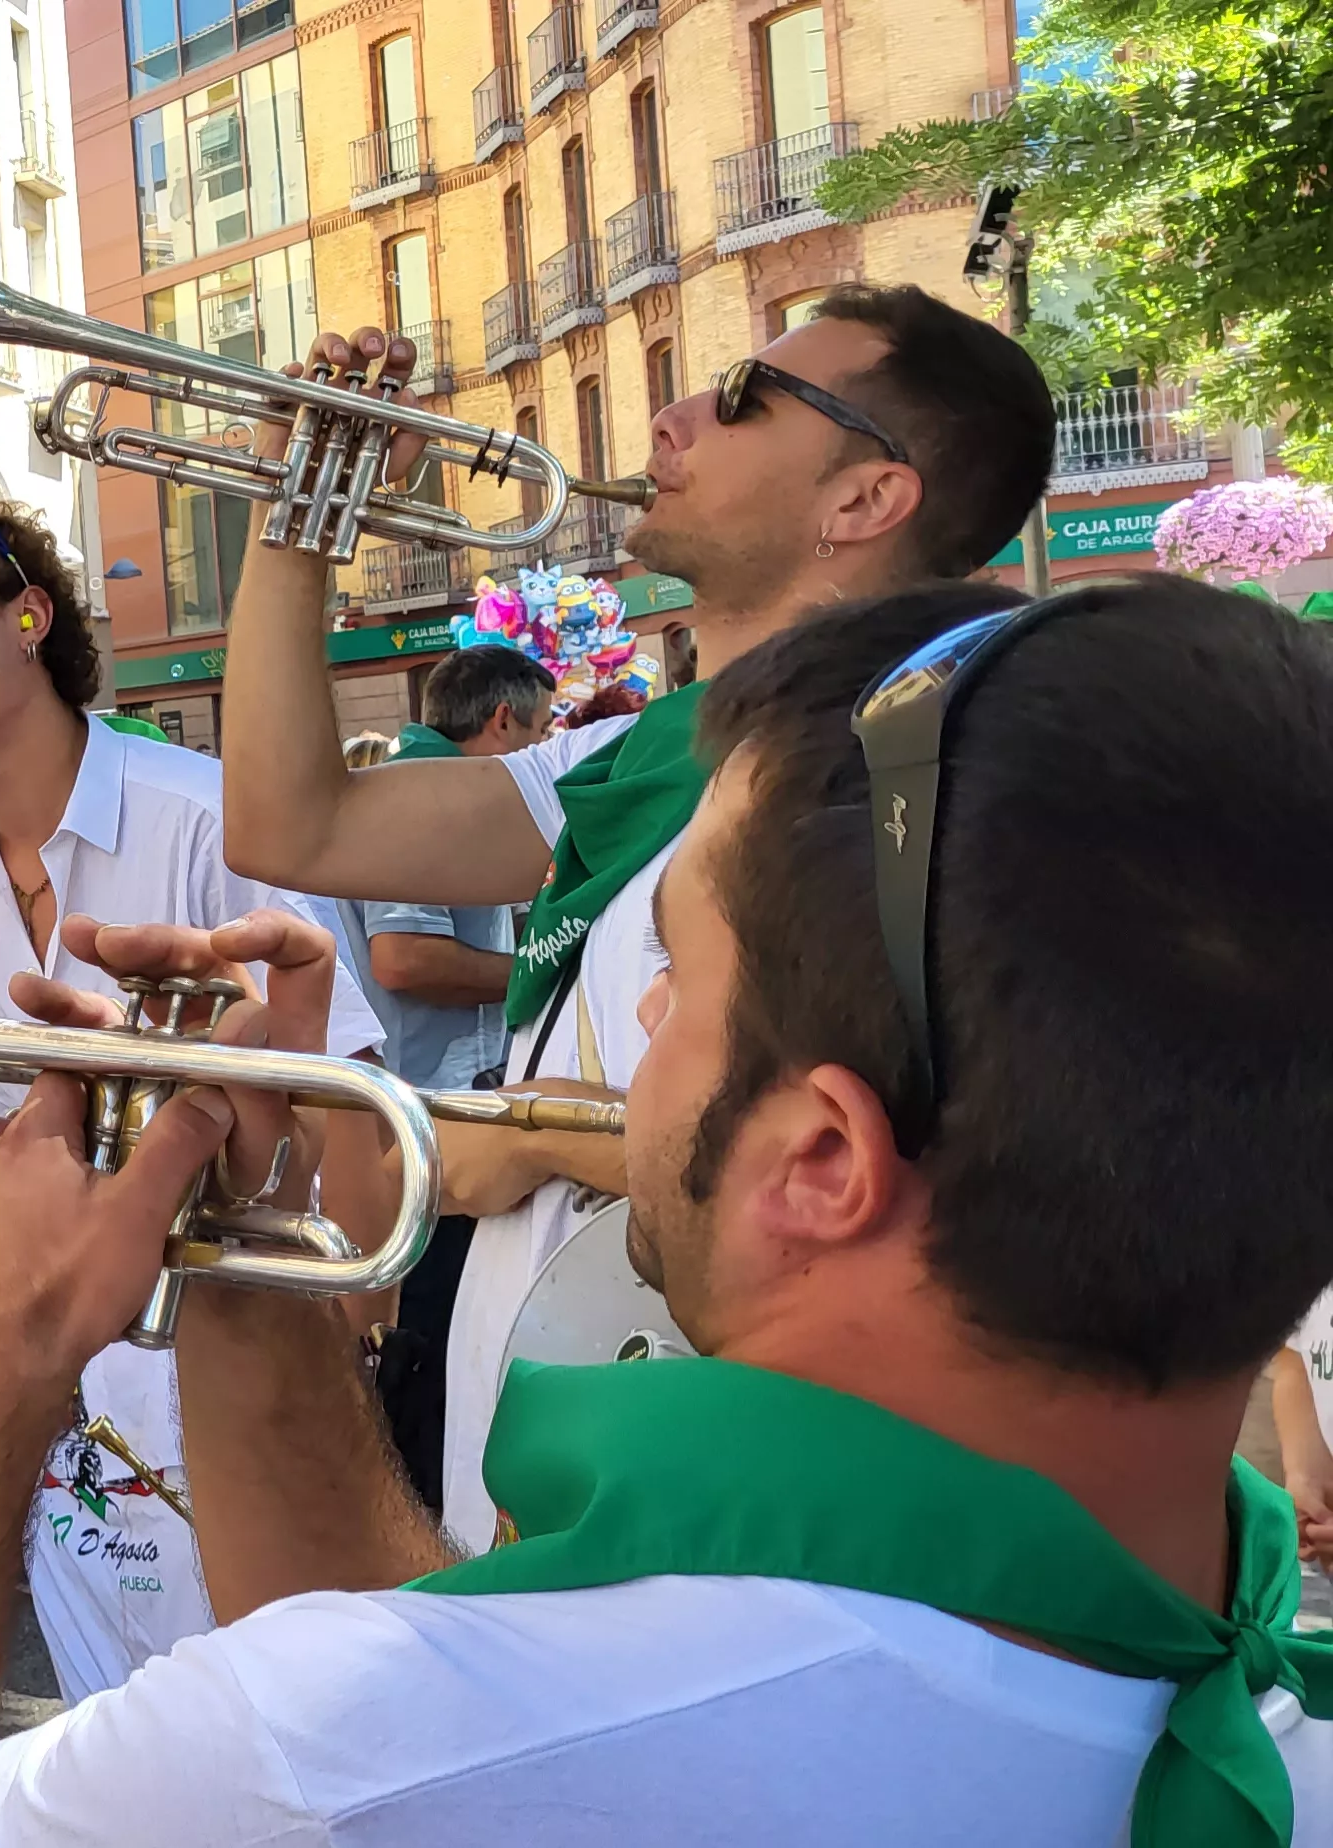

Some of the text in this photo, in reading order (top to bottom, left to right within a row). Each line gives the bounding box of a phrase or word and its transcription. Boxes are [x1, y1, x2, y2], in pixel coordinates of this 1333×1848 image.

[1063, 514, 1164, 537] CAJA RURA
[1077, 531, 1154, 550] DE ARAGÓ
[119, 1575, 164, 1593] HUESCA
